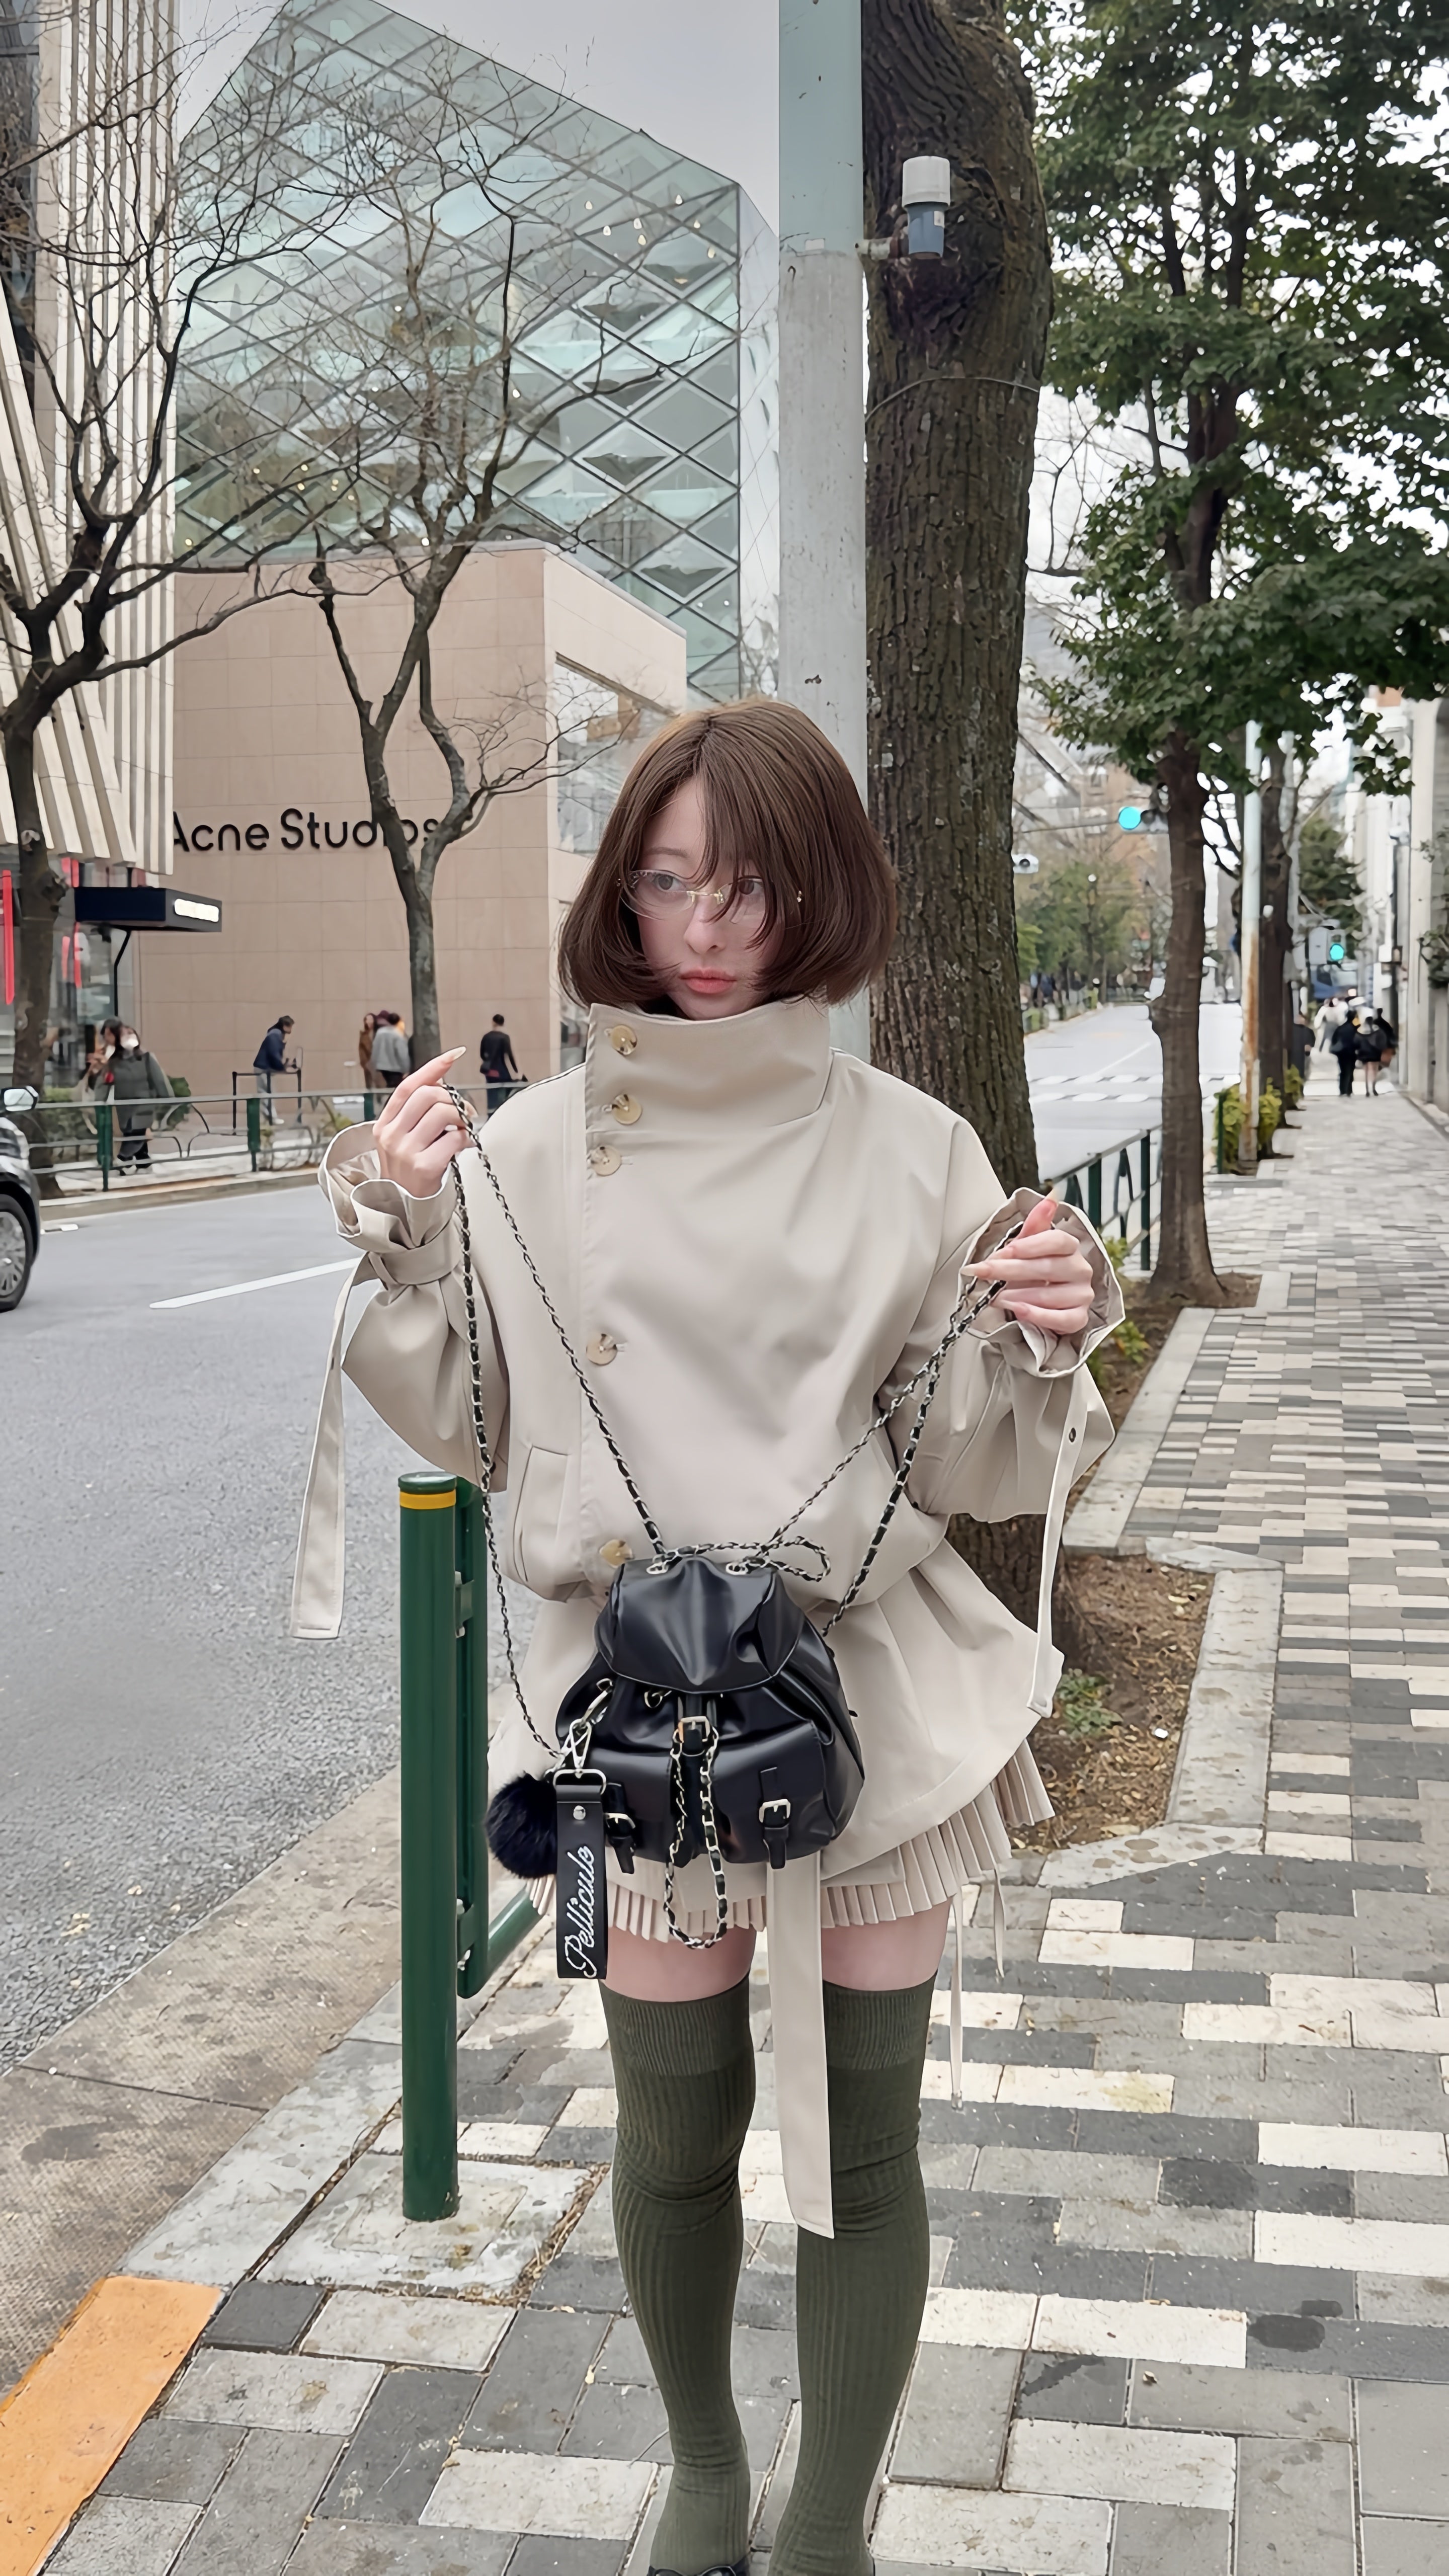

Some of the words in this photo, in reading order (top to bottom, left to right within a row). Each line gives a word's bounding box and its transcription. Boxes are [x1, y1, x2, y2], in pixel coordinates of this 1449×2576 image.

[173, 811, 269, 852] Acne
[280, 808, 439, 850] Studos
[565, 1845, 597, 1978] Pellicule
